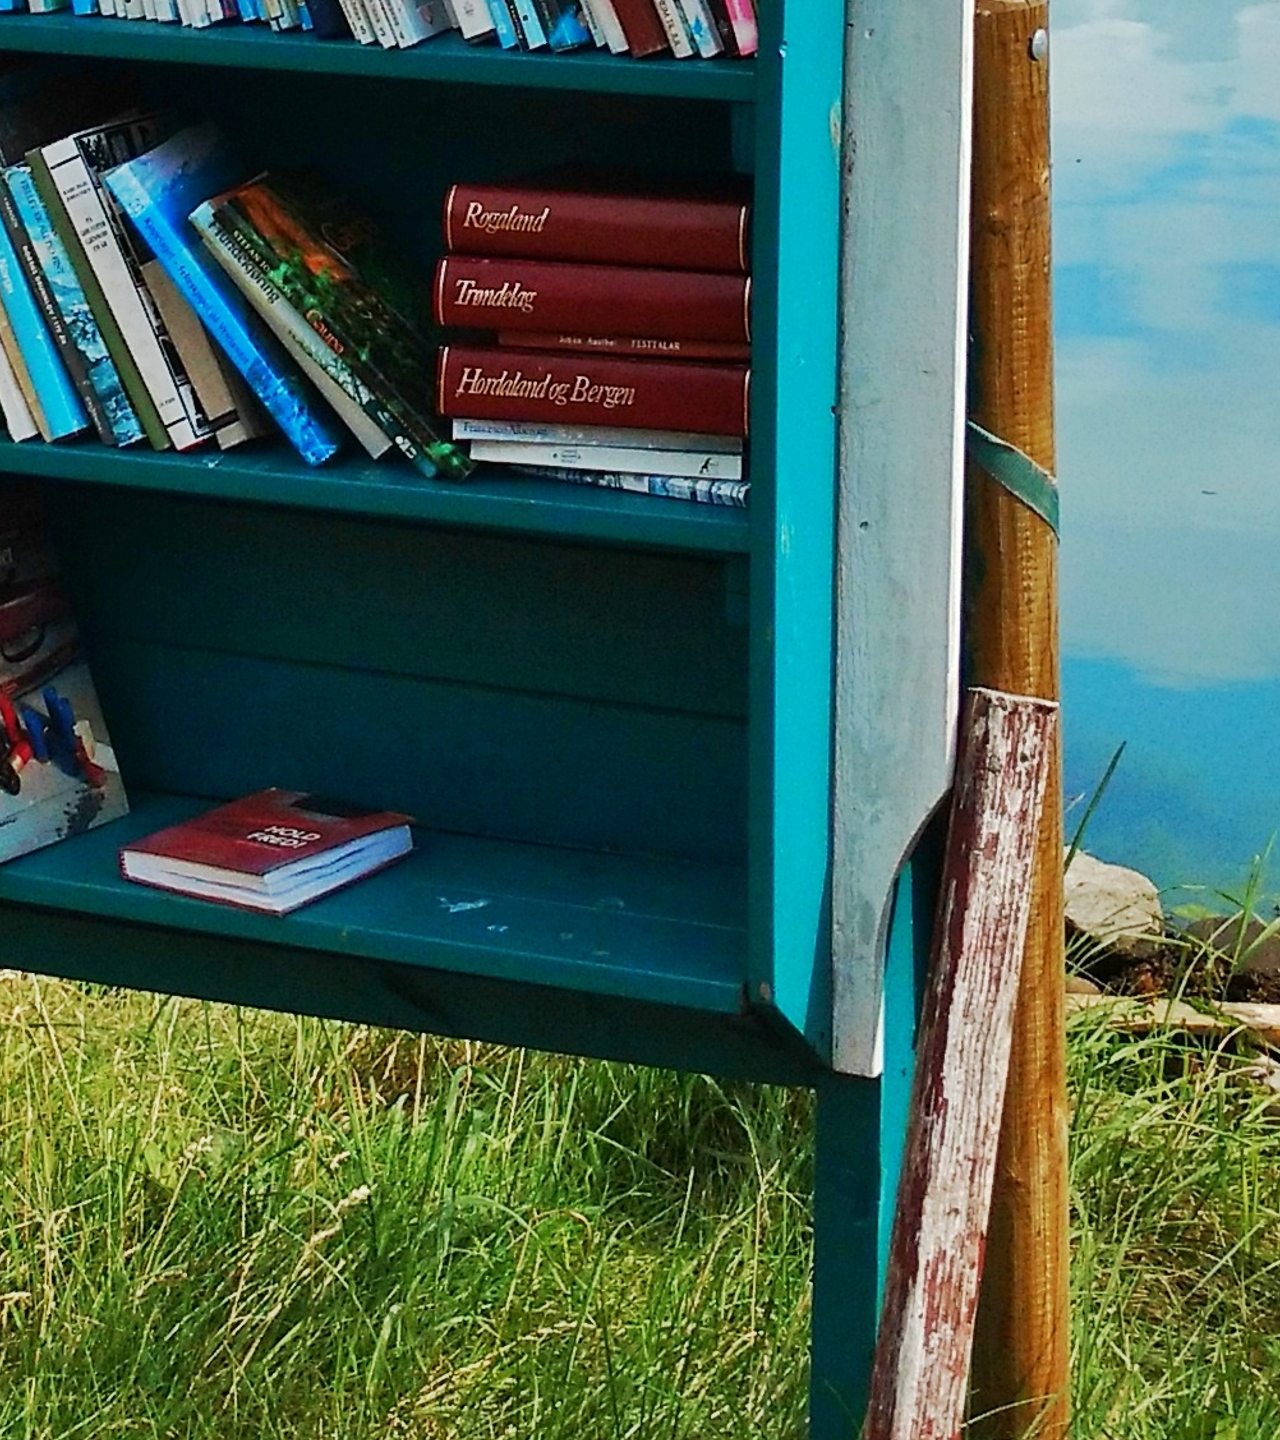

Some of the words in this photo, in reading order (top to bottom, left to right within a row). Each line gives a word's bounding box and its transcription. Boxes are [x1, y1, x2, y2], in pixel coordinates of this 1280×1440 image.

[463, 201, 550, 234] Rogaland
[201, 217, 285, 305] Hundekjøring
[230, 230, 262, 263] STEFAN
[454, 278, 537, 313] Trøndelag
[630, 338, 681, 351] FESTTALAR
[455, 366, 554, 400] Hordaland
[548, 381, 568, 405] og
[569, 374, 635, 409] Bergen
[264, 825, 322, 841] HOLD
